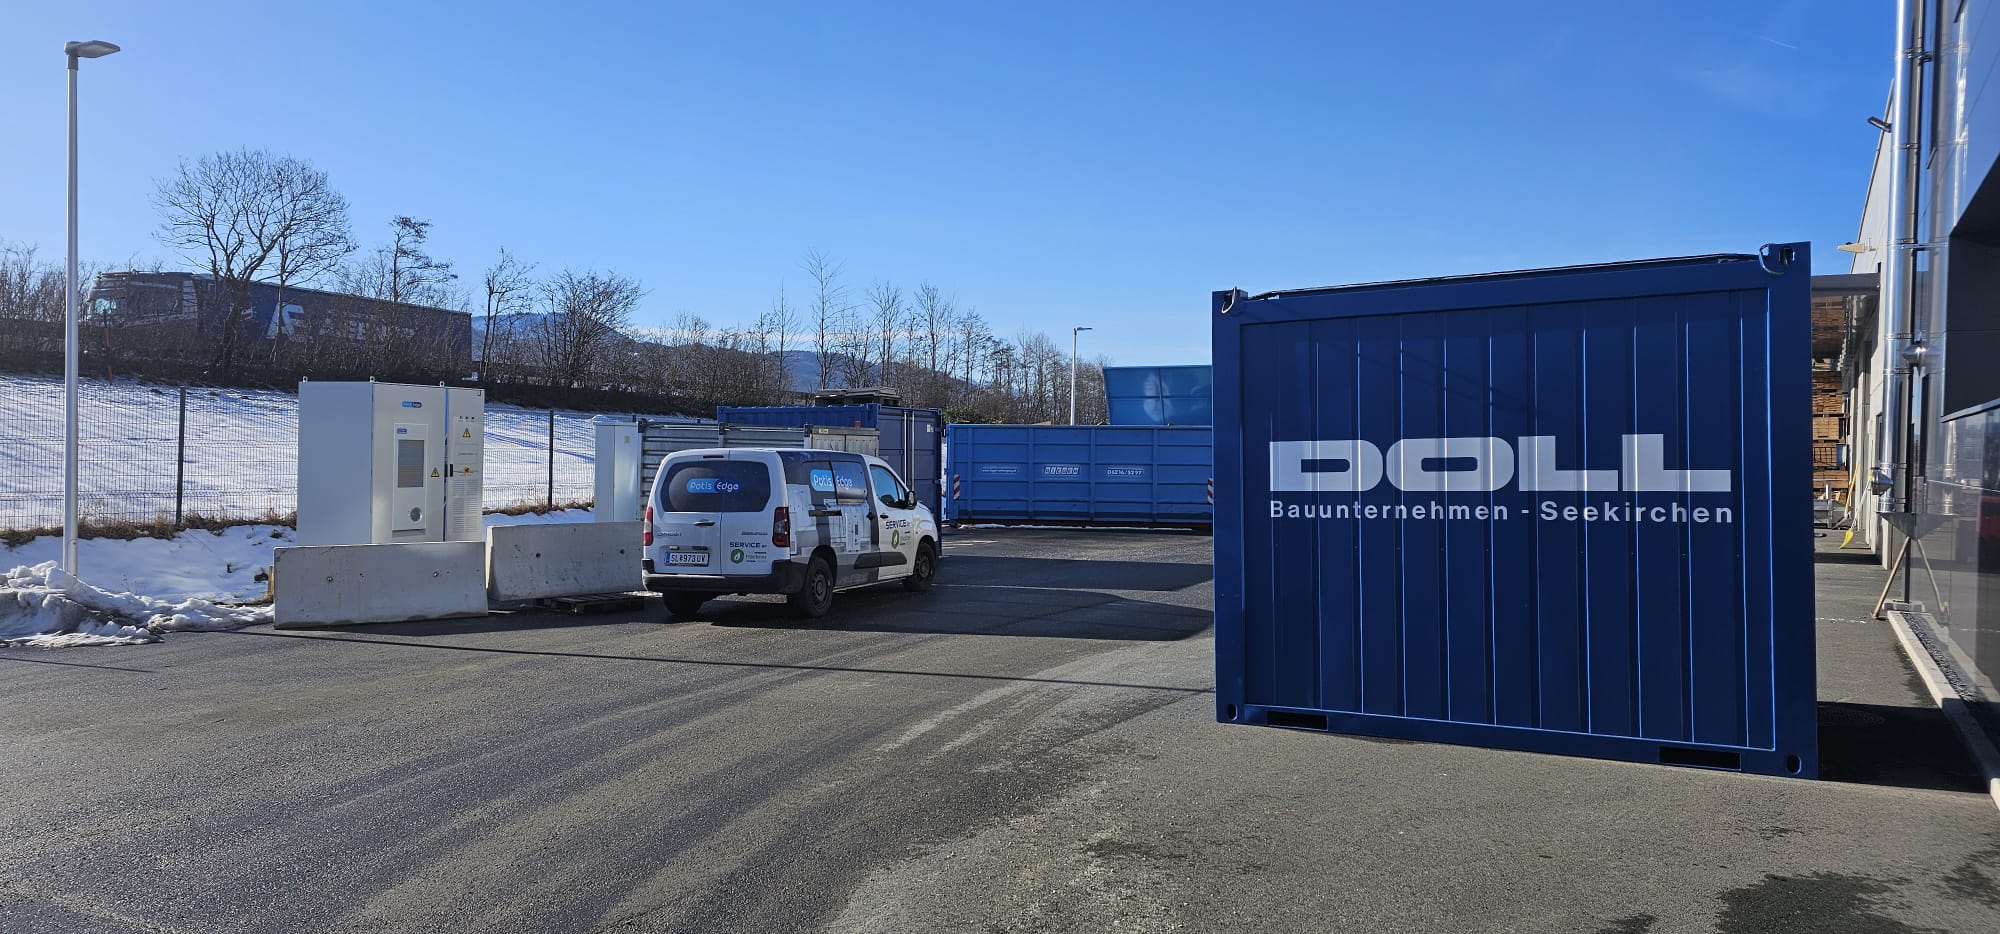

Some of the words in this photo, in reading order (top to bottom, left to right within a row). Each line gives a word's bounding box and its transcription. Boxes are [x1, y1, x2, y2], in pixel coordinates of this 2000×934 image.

[1269, 433, 1732, 492] DOLL
[689, 480, 713, 490] Potis
[716, 480, 740, 491] Edge
[813, 474, 832, 486] Potis
[836, 475, 853, 490] Edge
[1269, 499, 1509, 521] Bauunternehmen
[1540, 500, 1734, 524] Seekirchen
